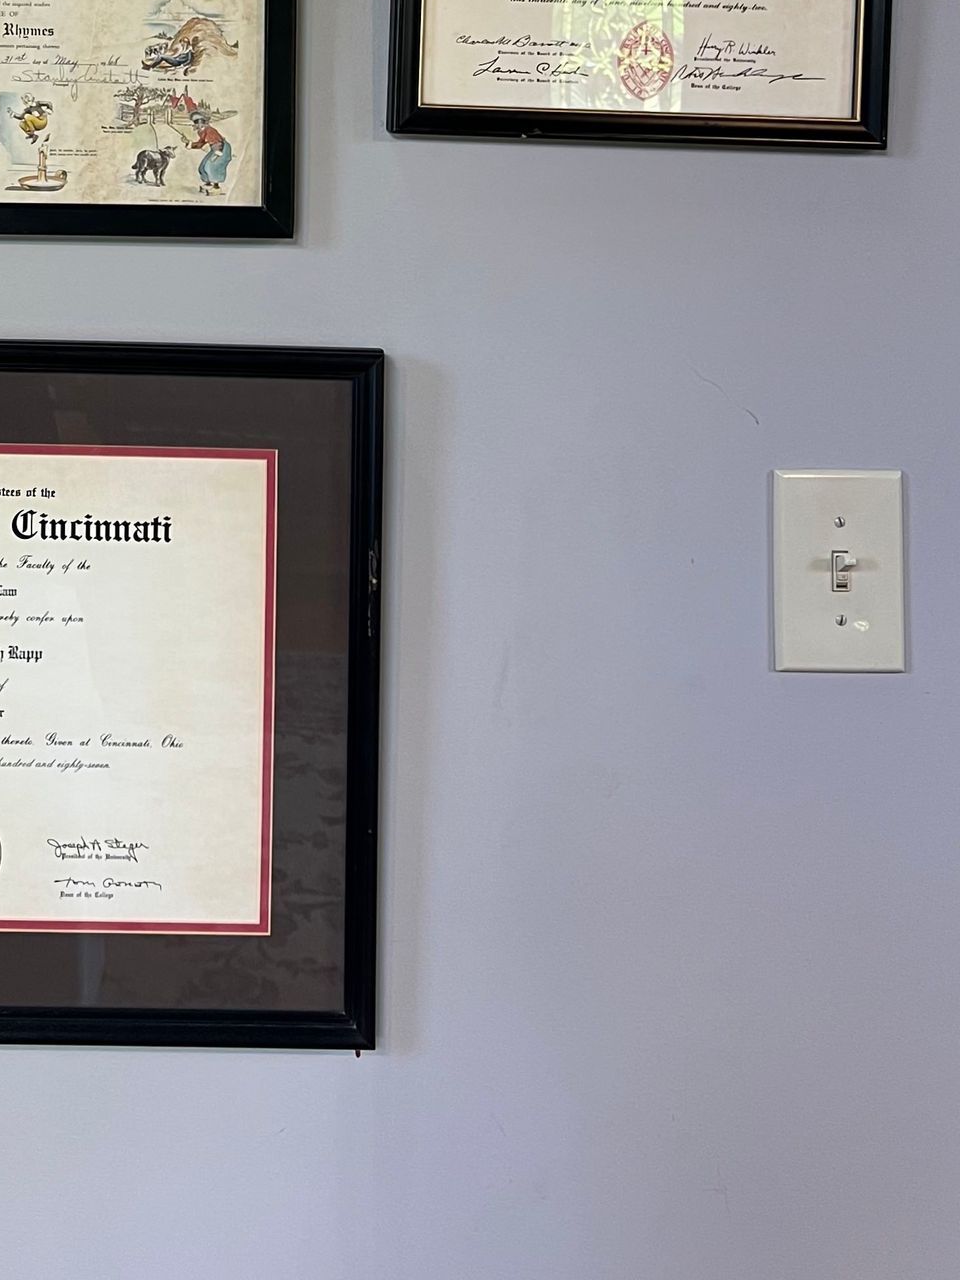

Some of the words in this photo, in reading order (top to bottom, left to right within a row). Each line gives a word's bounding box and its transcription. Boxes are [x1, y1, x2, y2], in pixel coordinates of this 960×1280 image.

[2, 23, 54, 39] Rhymes
[26, 487, 36, 497] of
[41, 488, 55, 499] the
[12, 510, 171, 542] Cincinnati
[17, 555, 55, 575] Faculty
[62, 559, 74, 573] of
[77, 560, 90, 570] the
[8, 646, 43, 662] Rapp
[45, 732, 73, 746] Given
[80, 739, 91, 747] at
[100, 734, 152, 748] Cincinnati,
[161, 734, 183, 748] Ohio
